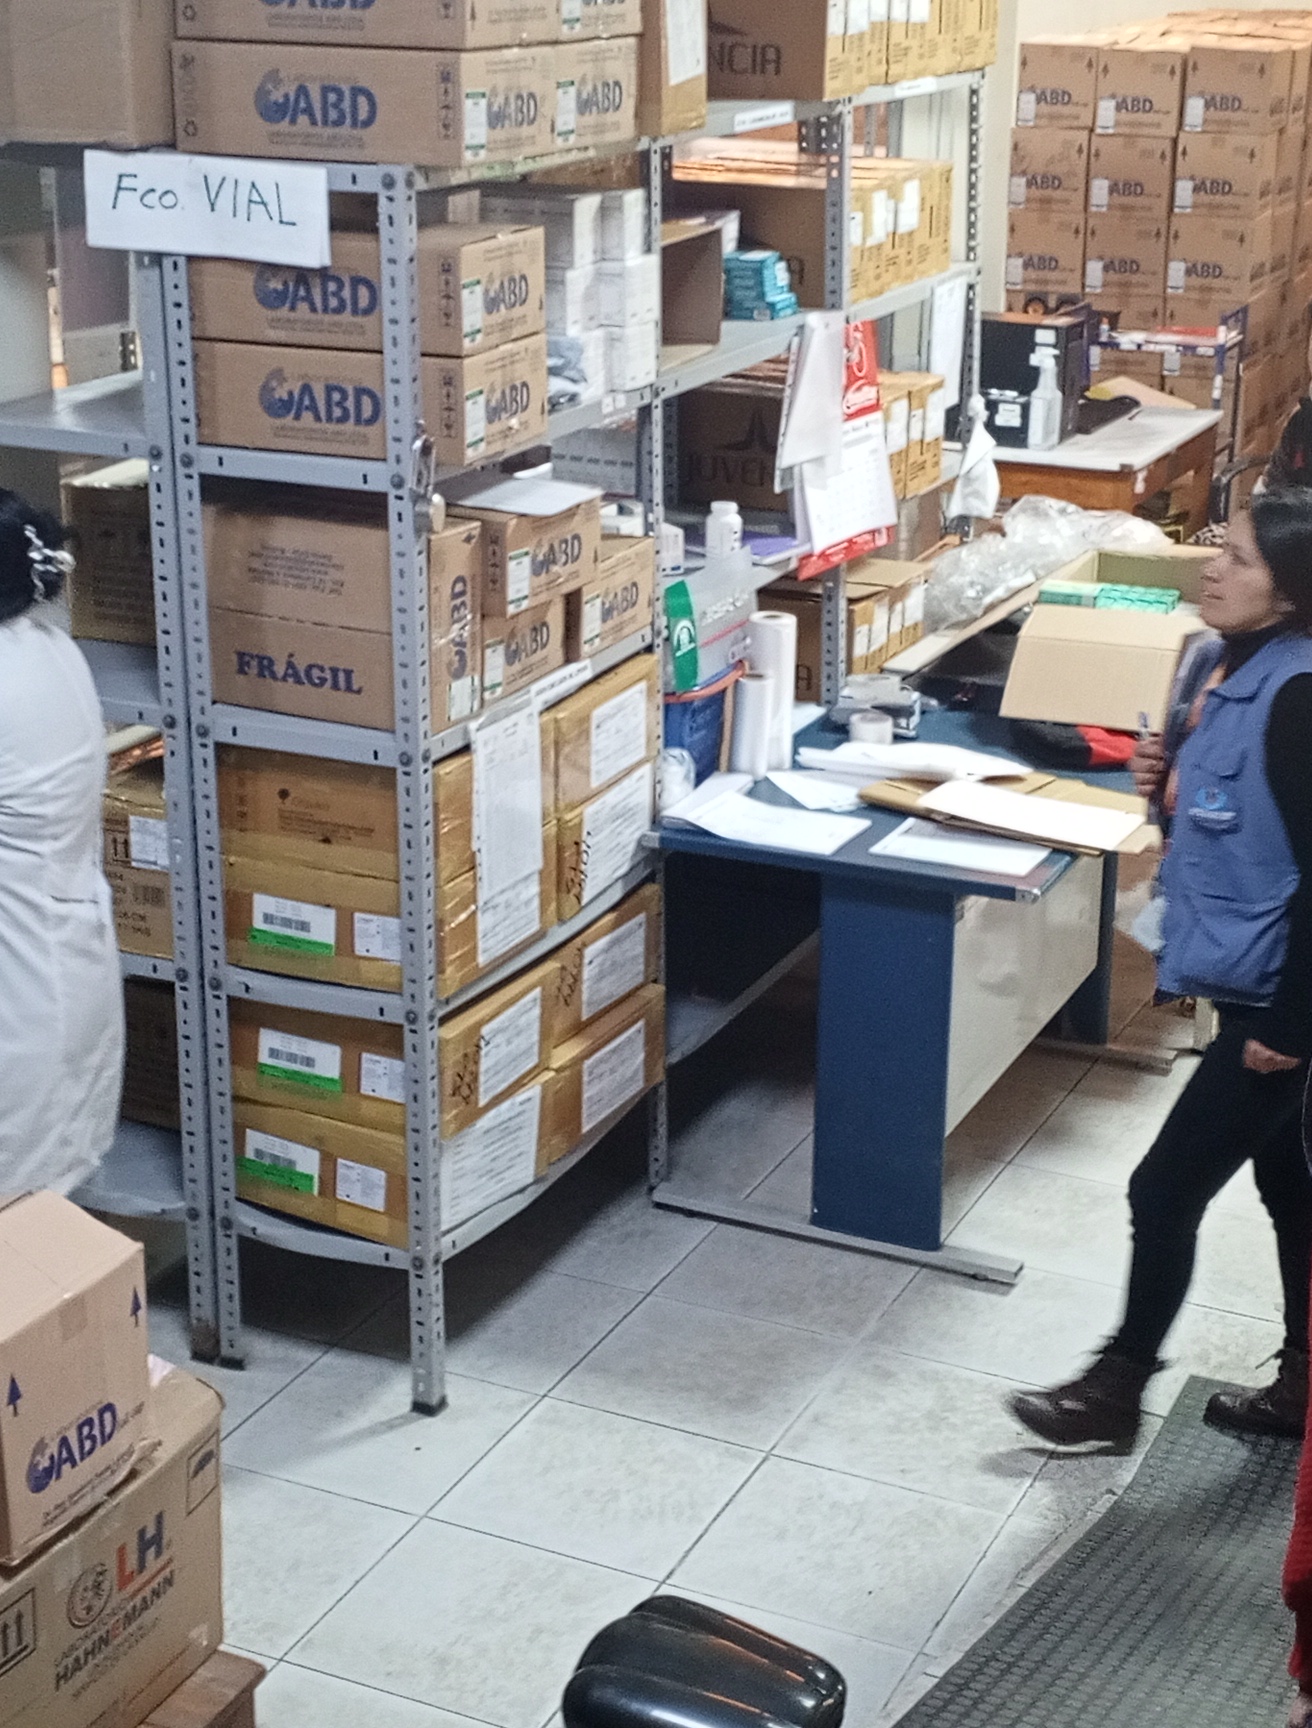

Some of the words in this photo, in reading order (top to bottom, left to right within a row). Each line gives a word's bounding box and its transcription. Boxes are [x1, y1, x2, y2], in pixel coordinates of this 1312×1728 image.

[202, 174, 297, 228] VIAL
[234, 650, 363, 696] FRÁGIL
[116, 1510, 164, 1591] LH
